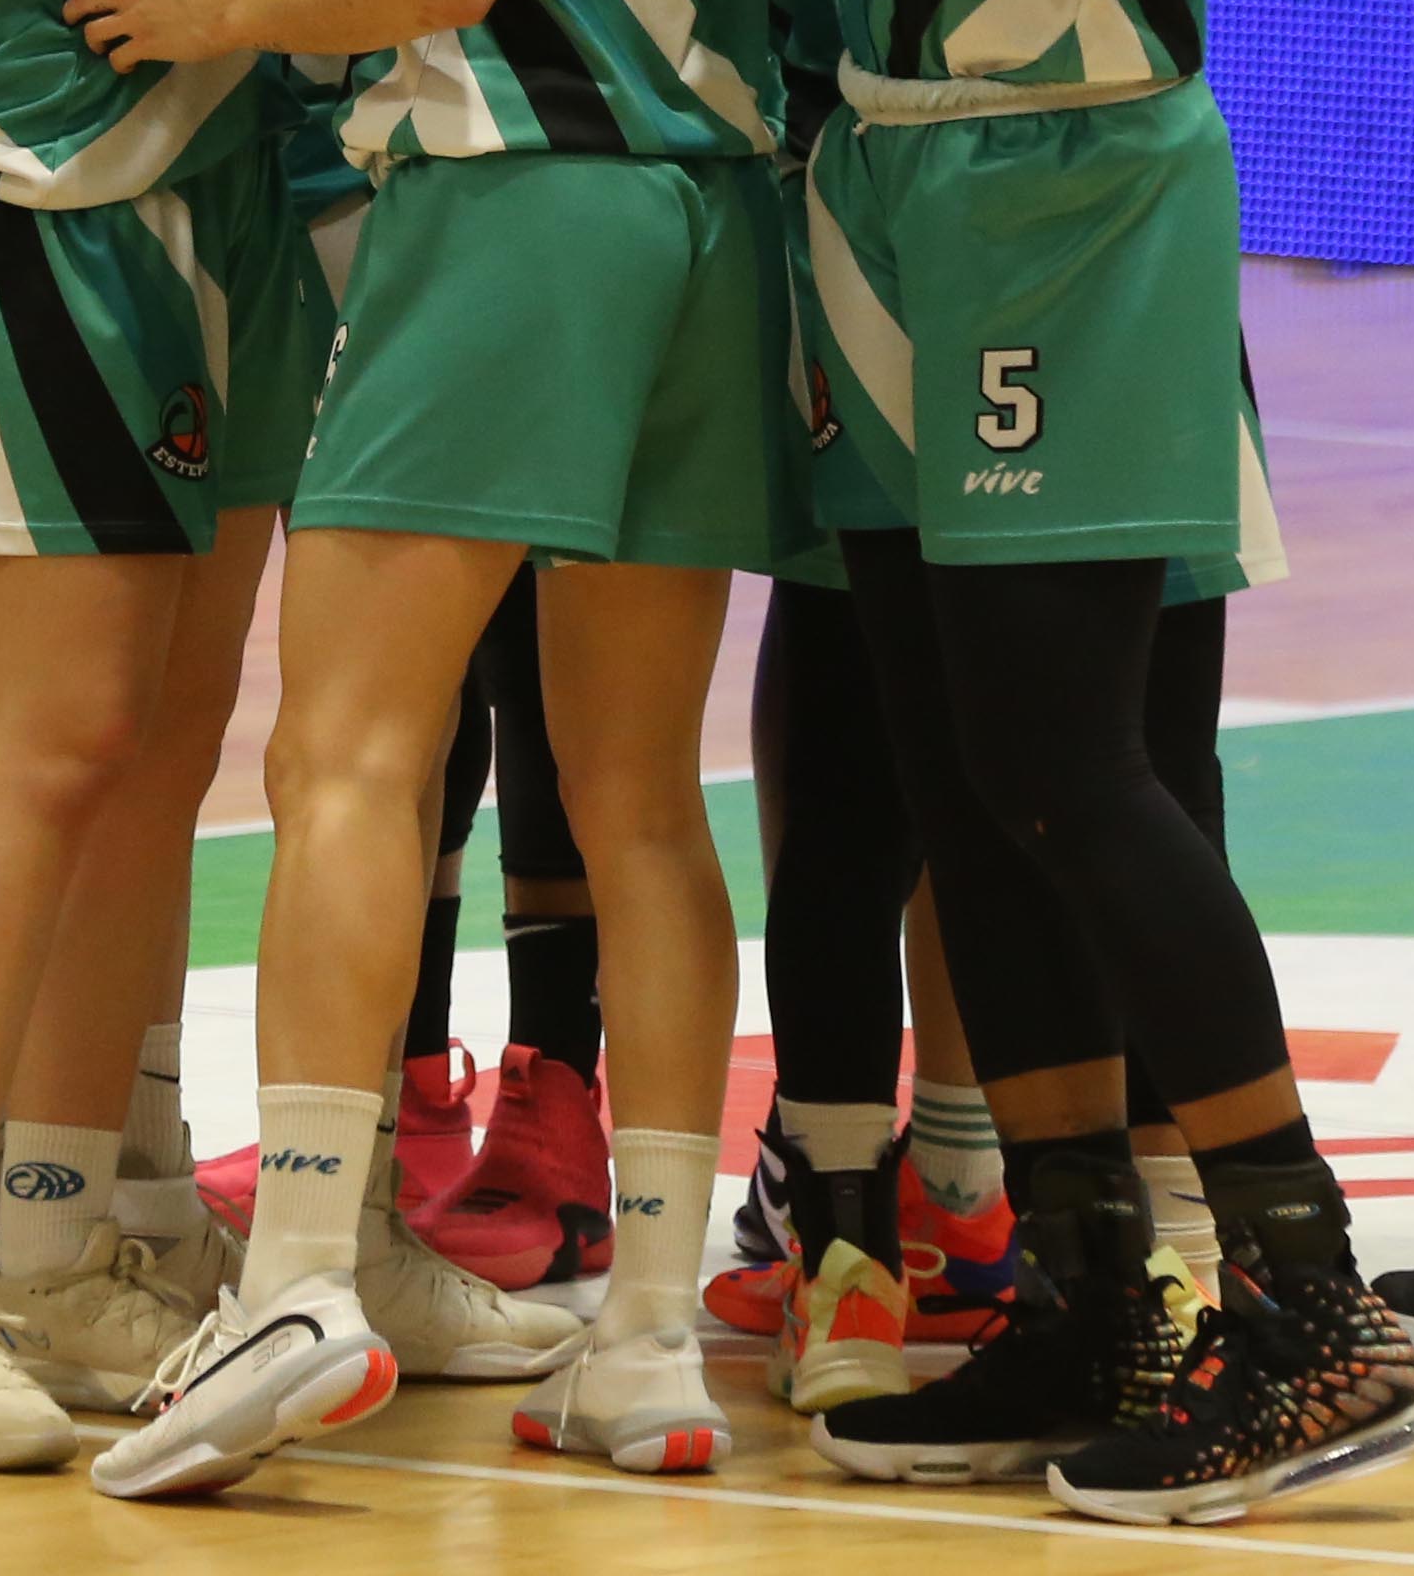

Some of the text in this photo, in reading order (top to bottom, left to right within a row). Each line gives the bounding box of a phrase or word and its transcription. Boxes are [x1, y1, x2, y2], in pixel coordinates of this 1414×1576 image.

[975, 347, 1044, 454] 5
[962, 460, 1044, 496] vive
[260, 1147, 343, 1175] vive
